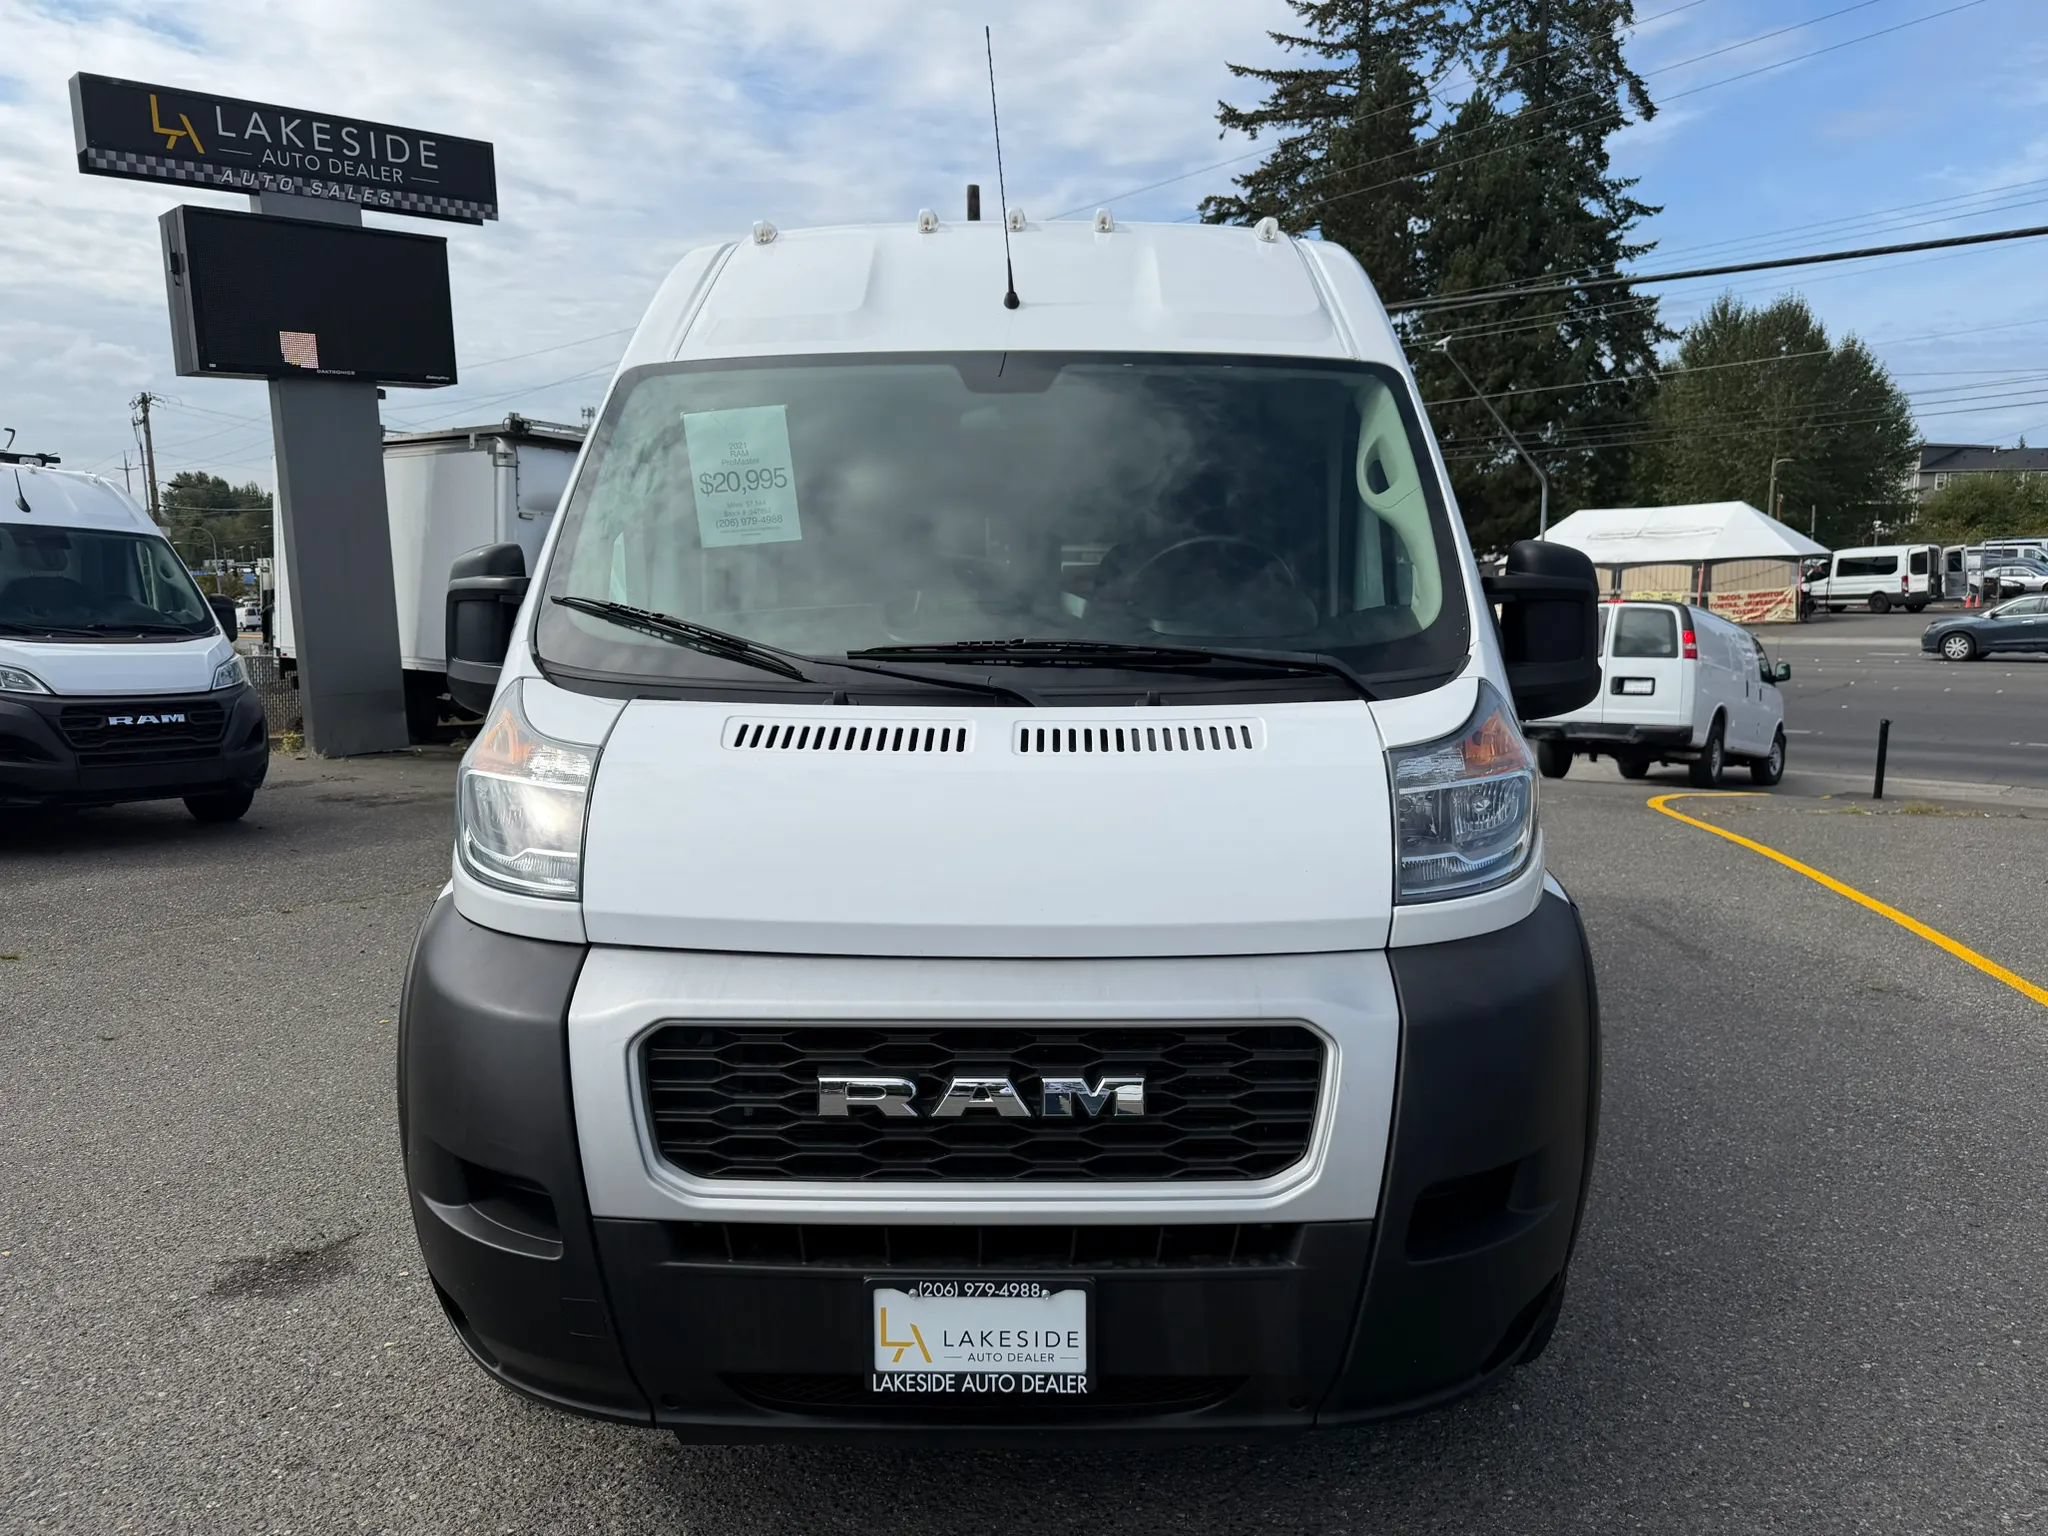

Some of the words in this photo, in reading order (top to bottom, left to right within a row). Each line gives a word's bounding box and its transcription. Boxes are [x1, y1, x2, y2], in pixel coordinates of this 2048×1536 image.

[215, 105, 439, 169] LAKESIDE
[261, 148, 321, 171] AUTO
[328, 158, 404, 184] DEALER
[221, 169, 293, 192] AUTO
[311, 181, 392, 205] SALES
[729, 450, 749, 458] RAM
[699, 467, 788, 497] $20,995
[715, 517, 739, 529] (206)
[108, 713, 186, 726] RAM
[817, 1076, 1146, 1118] RAM
[918, 1281, 959, 1298] (206)
[964, 1283, 1041, 1298] 979-4988
[943, 1330, 1080, 1348] LAKESIDE
[967, 1352, 1003, 1363] AUTO
[1007, 1352, 1055, 1363] DEALER
[872, 1373, 956, 1393] LAKESIDE
[961, 1373, 1016, 1393] AUTO
[1021, 1374, 1088, 1394] DEALER
